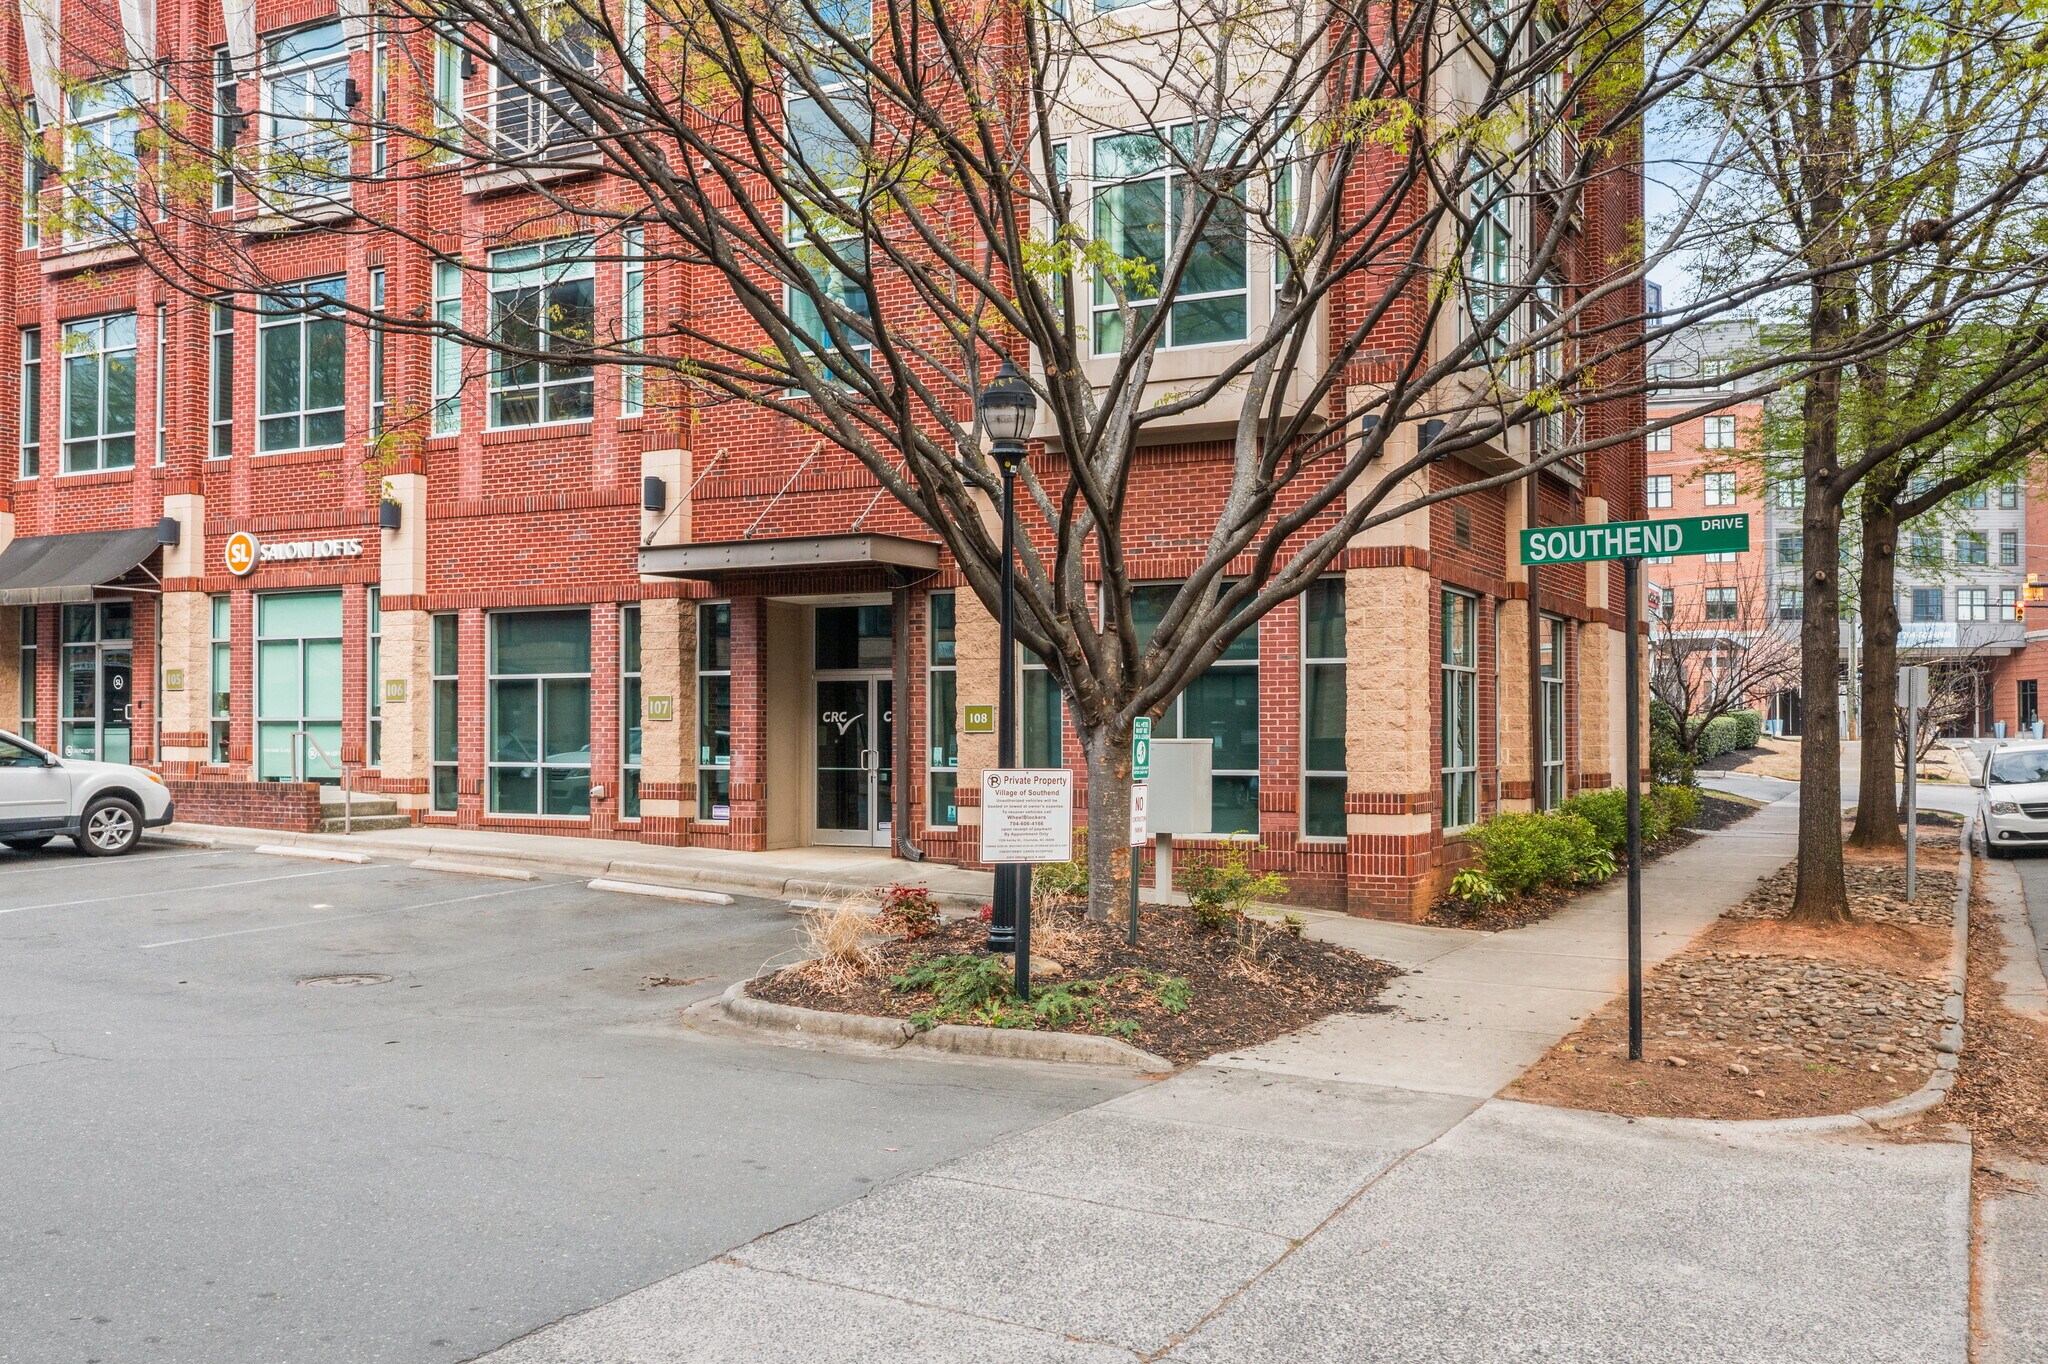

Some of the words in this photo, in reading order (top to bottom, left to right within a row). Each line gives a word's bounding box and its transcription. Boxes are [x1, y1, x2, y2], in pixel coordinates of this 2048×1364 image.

[1529, 524, 1683, 560] SOUTHEND
[1701, 518, 1744, 531] DRIVE
[231, 543, 249, 563] SL
[260, 541, 312, 560] SALON
[314, 538, 364, 557] LOFTS
[167, 673, 181, 686] 105
[387, 684, 404, 697] 106
[649, 700, 669, 714] 107
[822, 711, 847, 722] CRC
[970, 713, 987, 723] 108
[1003, 776, 1031, 785] Private
[1033, 776, 1067, 787] Property
[1135, 796, 1144, 811] NO
